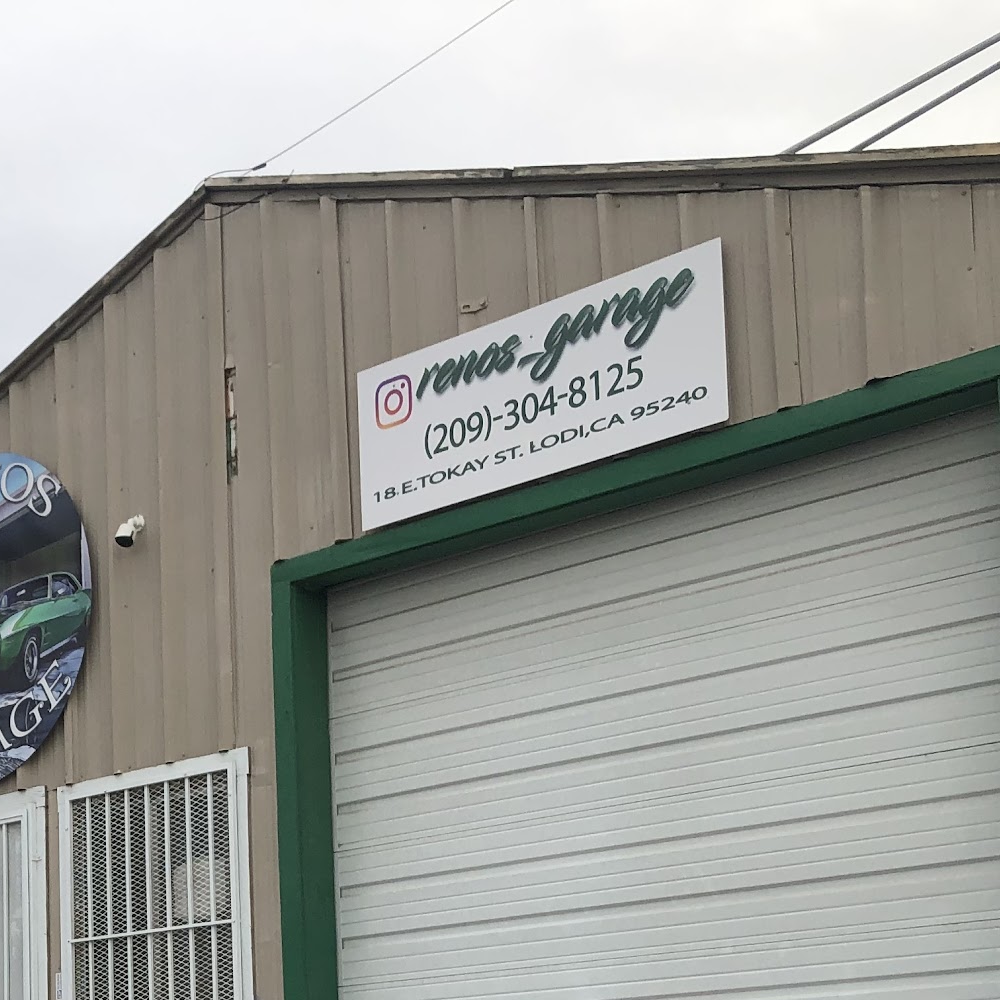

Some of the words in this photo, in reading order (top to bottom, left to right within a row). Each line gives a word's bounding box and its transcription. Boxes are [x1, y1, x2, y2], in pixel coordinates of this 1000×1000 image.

[425, 355, 644, 460] (209)-304-8125
[494, 444, 524, 466] ST.
[630, 386, 708, 421] 95240
